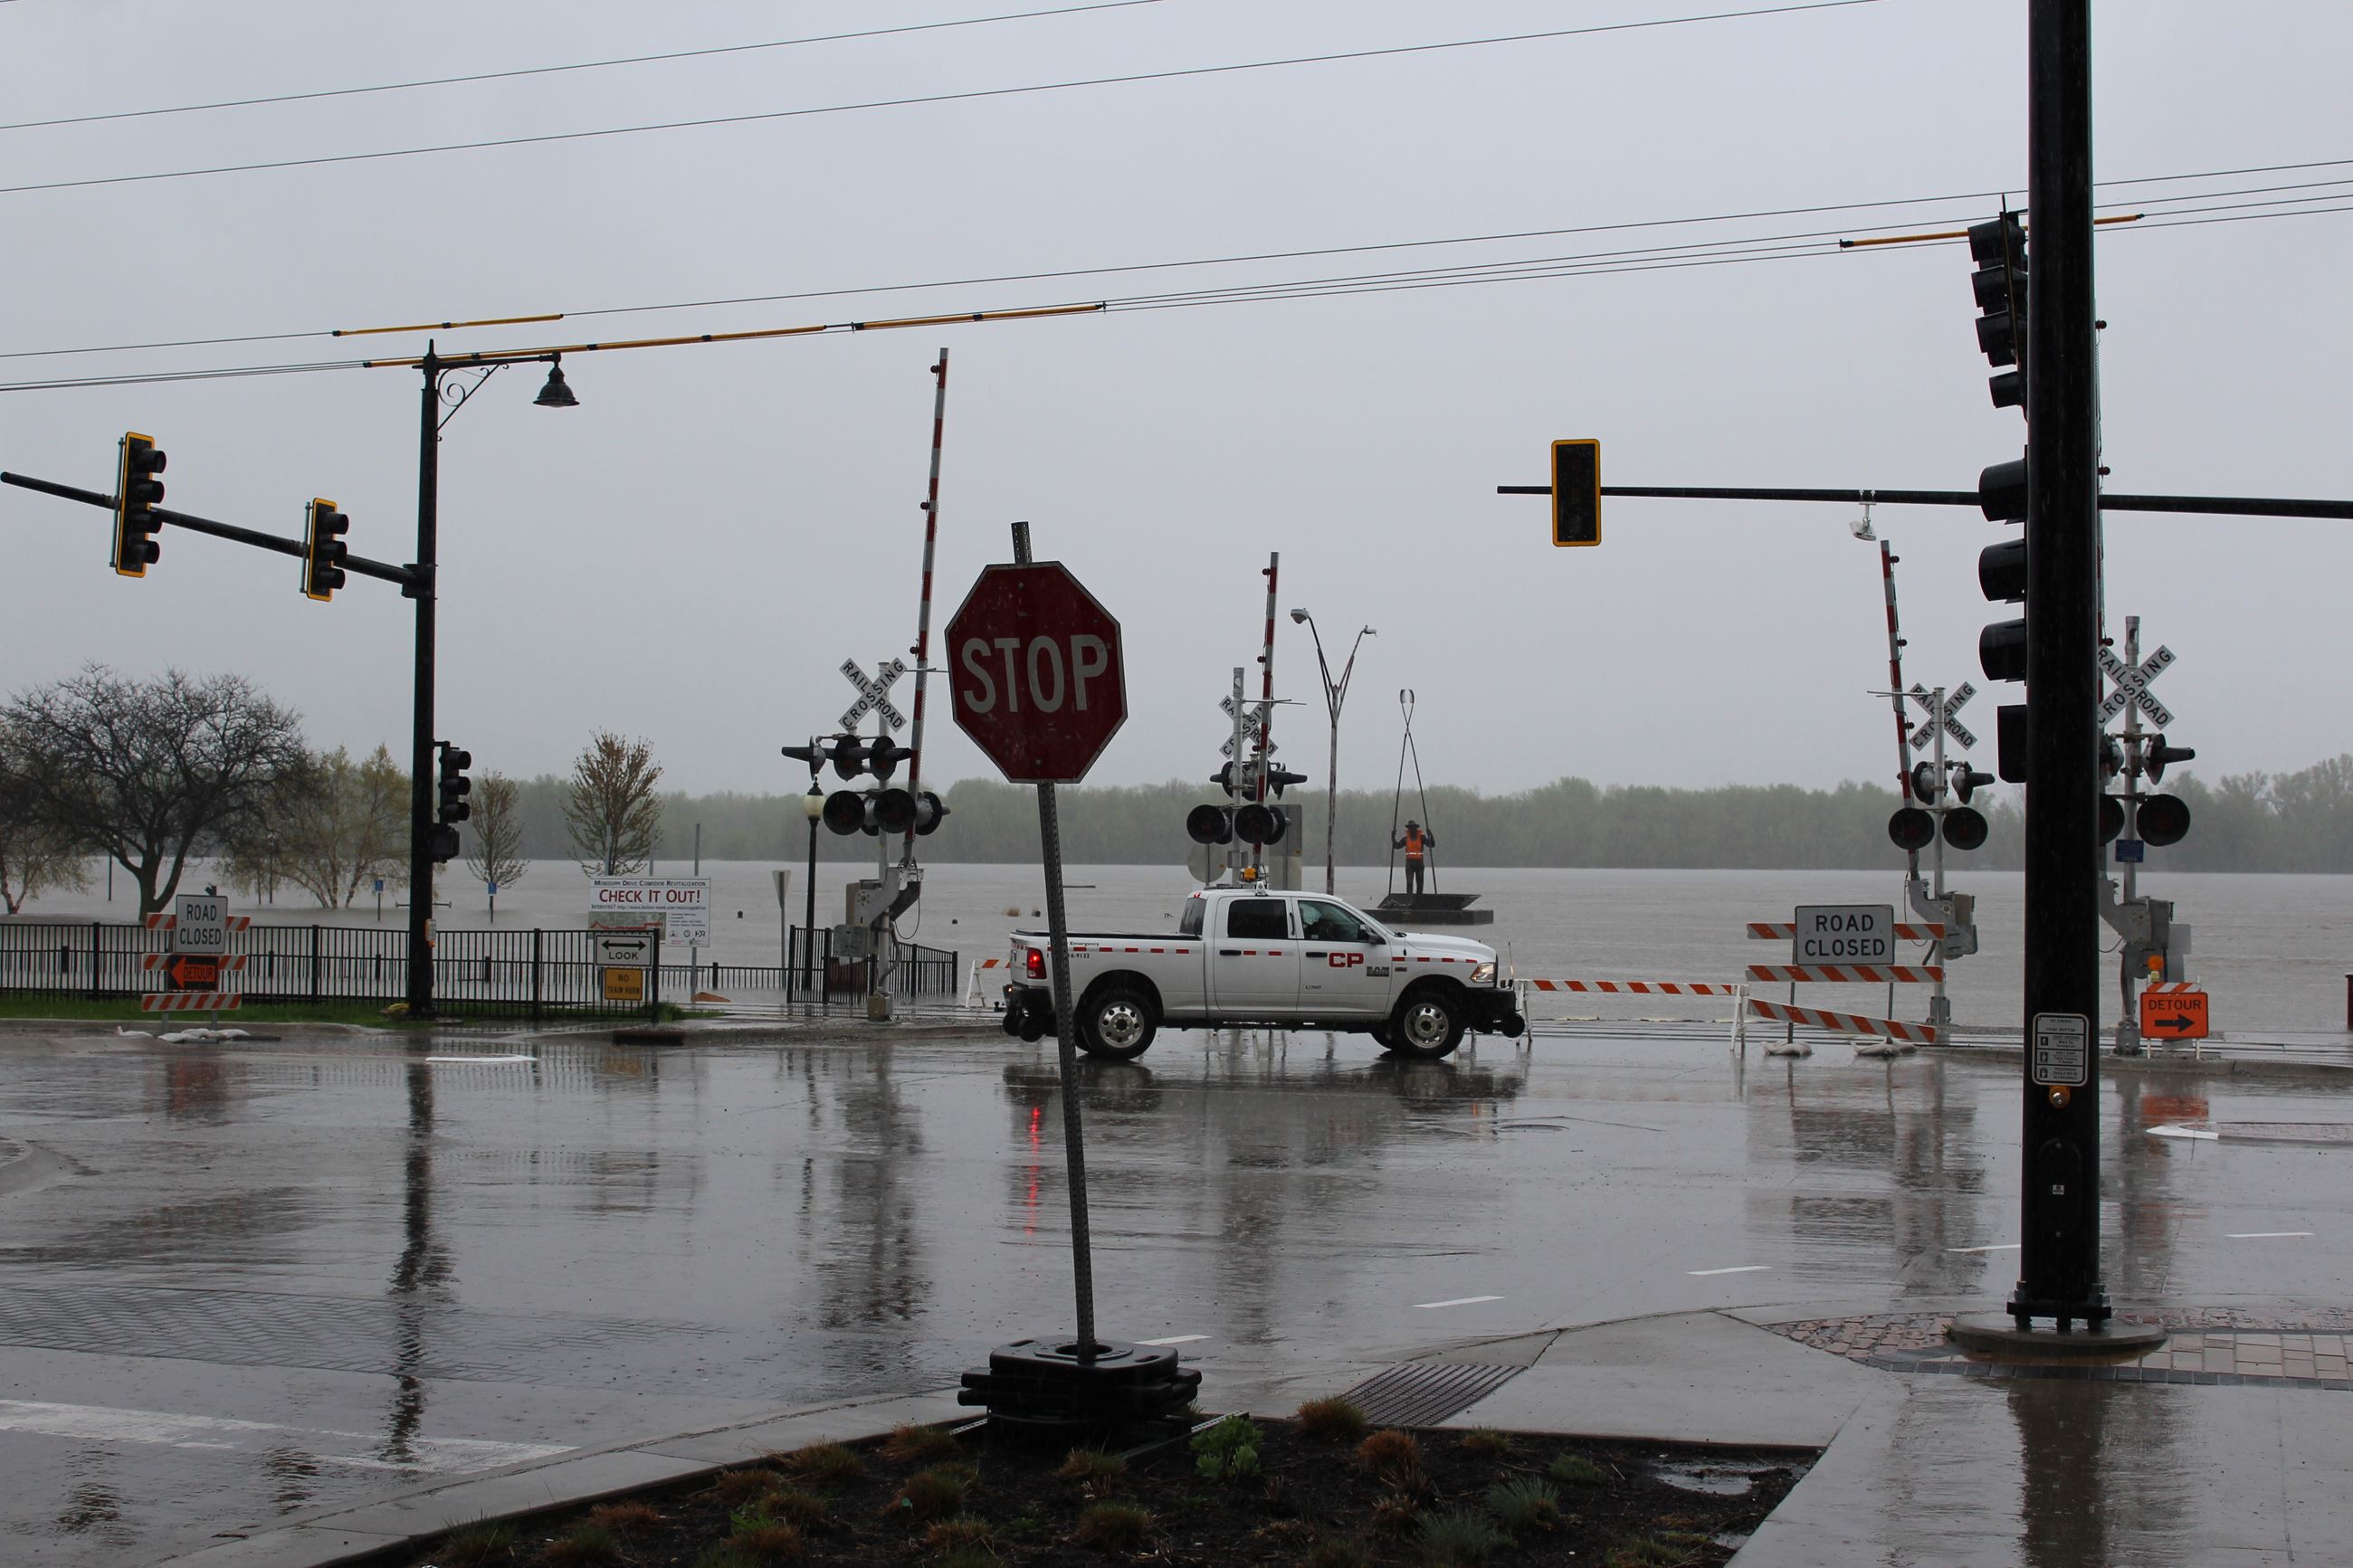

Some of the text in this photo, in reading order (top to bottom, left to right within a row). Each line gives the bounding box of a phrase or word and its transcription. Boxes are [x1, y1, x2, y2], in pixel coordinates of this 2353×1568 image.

[962, 634, 1109, 714] STOP
[842, 661, 904, 727] CROSSING
[1912, 685, 1974, 747] CROSING
[599, 889, 700, 903] CHECK IT OUT!
[186, 903, 217, 921] ROAD
[1815, 915, 1873, 932] ROAD
[179, 927, 222, 945] CLOSED
[608, 951, 638, 960] LOOK
[1805, 939, 1885, 956] CLOSED
[1329, 953, 1365, 968] CP
[183, 965, 214, 980] DETOUR
[617, 974, 629, 983] NO
[2148, 999, 2202, 1011] DETOUR
